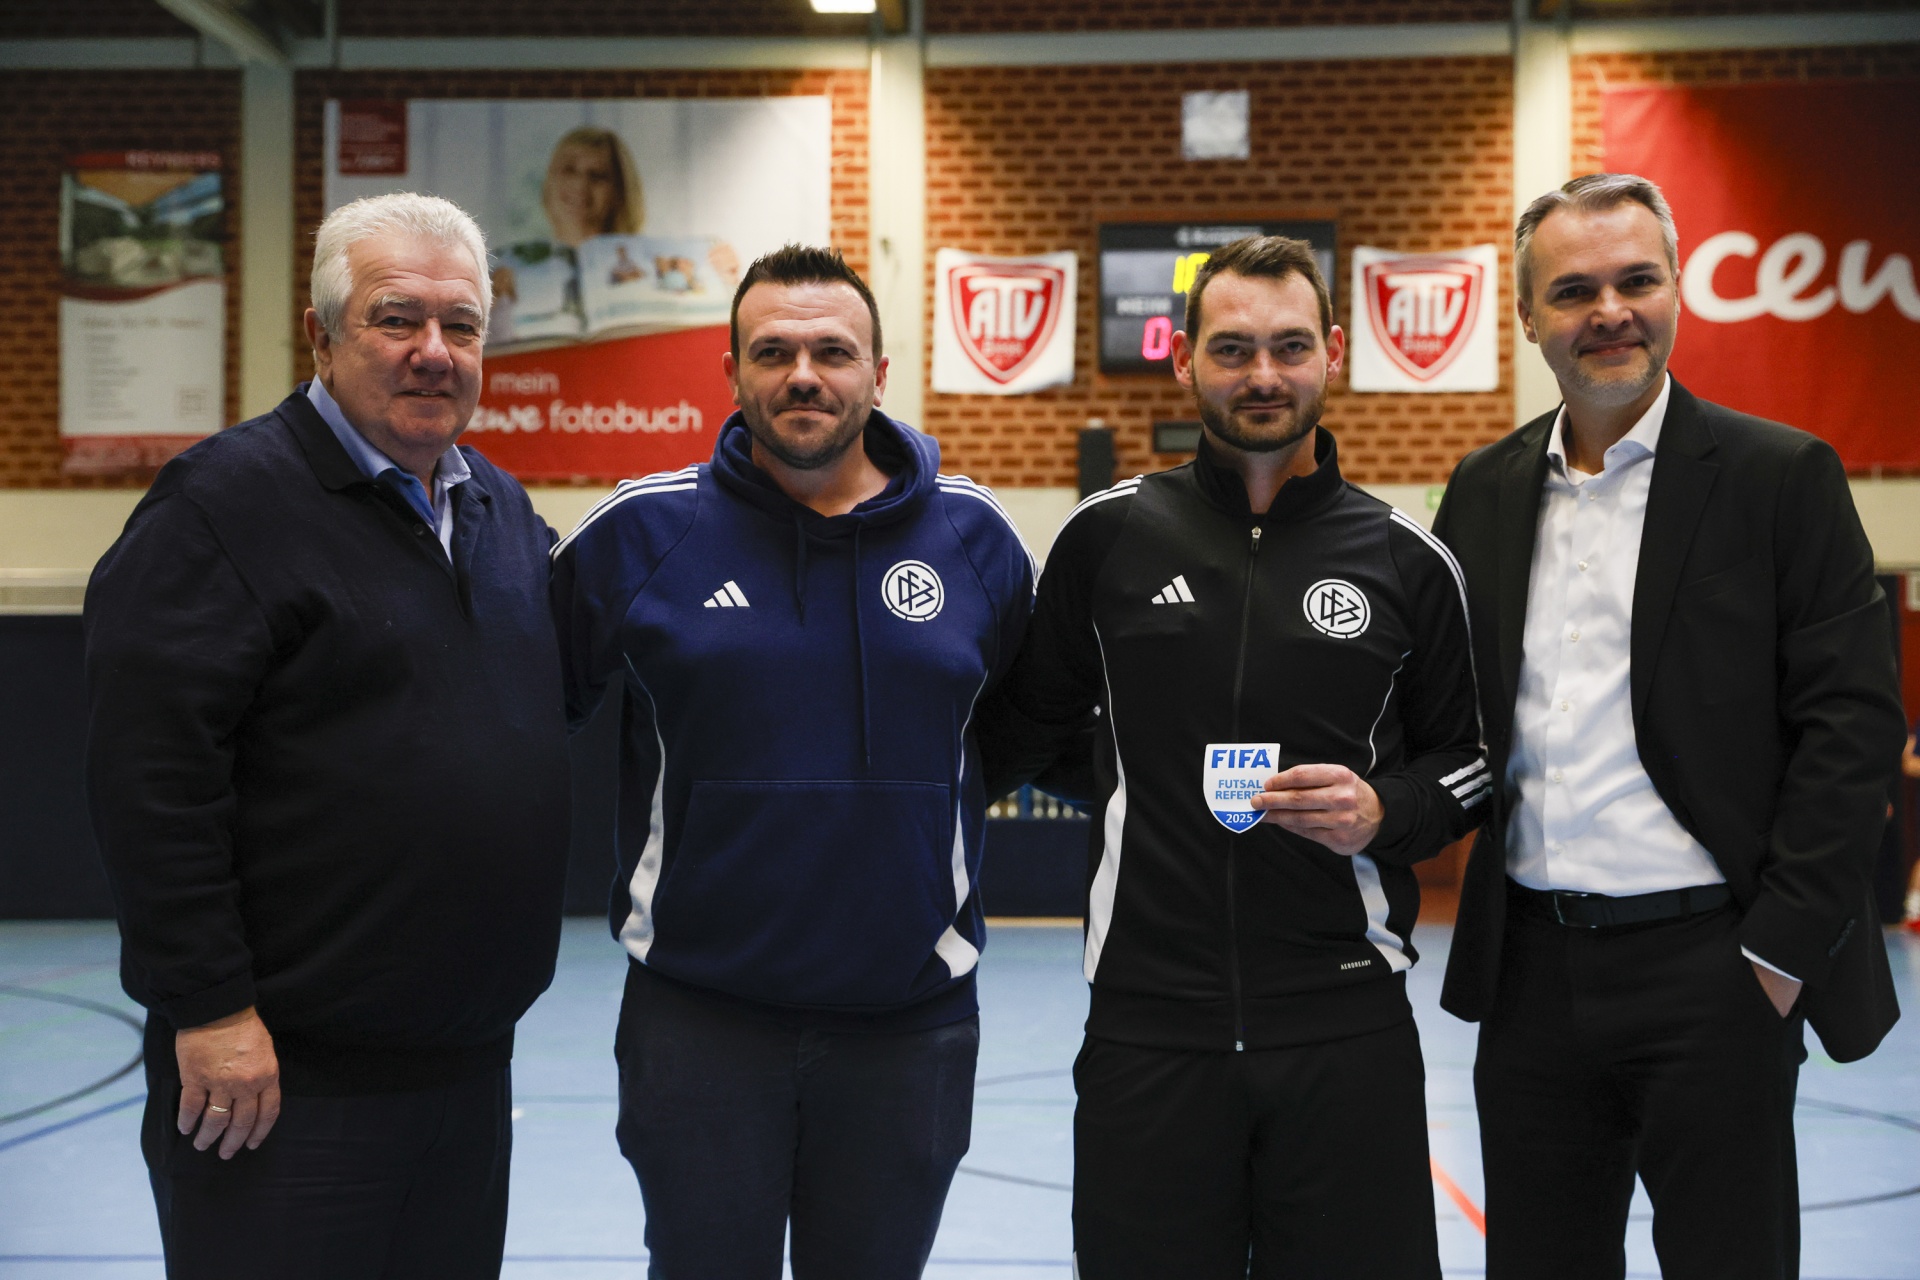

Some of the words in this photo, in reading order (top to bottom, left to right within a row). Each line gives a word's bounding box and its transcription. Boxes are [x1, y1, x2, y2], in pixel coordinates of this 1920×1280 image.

[968, 276, 1044, 339] ATV
[1386, 274, 1464, 337] ATV
[1142, 316, 1172, 360] 0
[490, 369, 559, 394] mein
[465, 405, 544, 433] ewe
[549, 399, 703, 433] fotobuch
[1211, 749, 1271, 768] FIFA
[1218, 779, 1263, 789] FUTSAL
[1225, 813, 1253, 824] 2025
